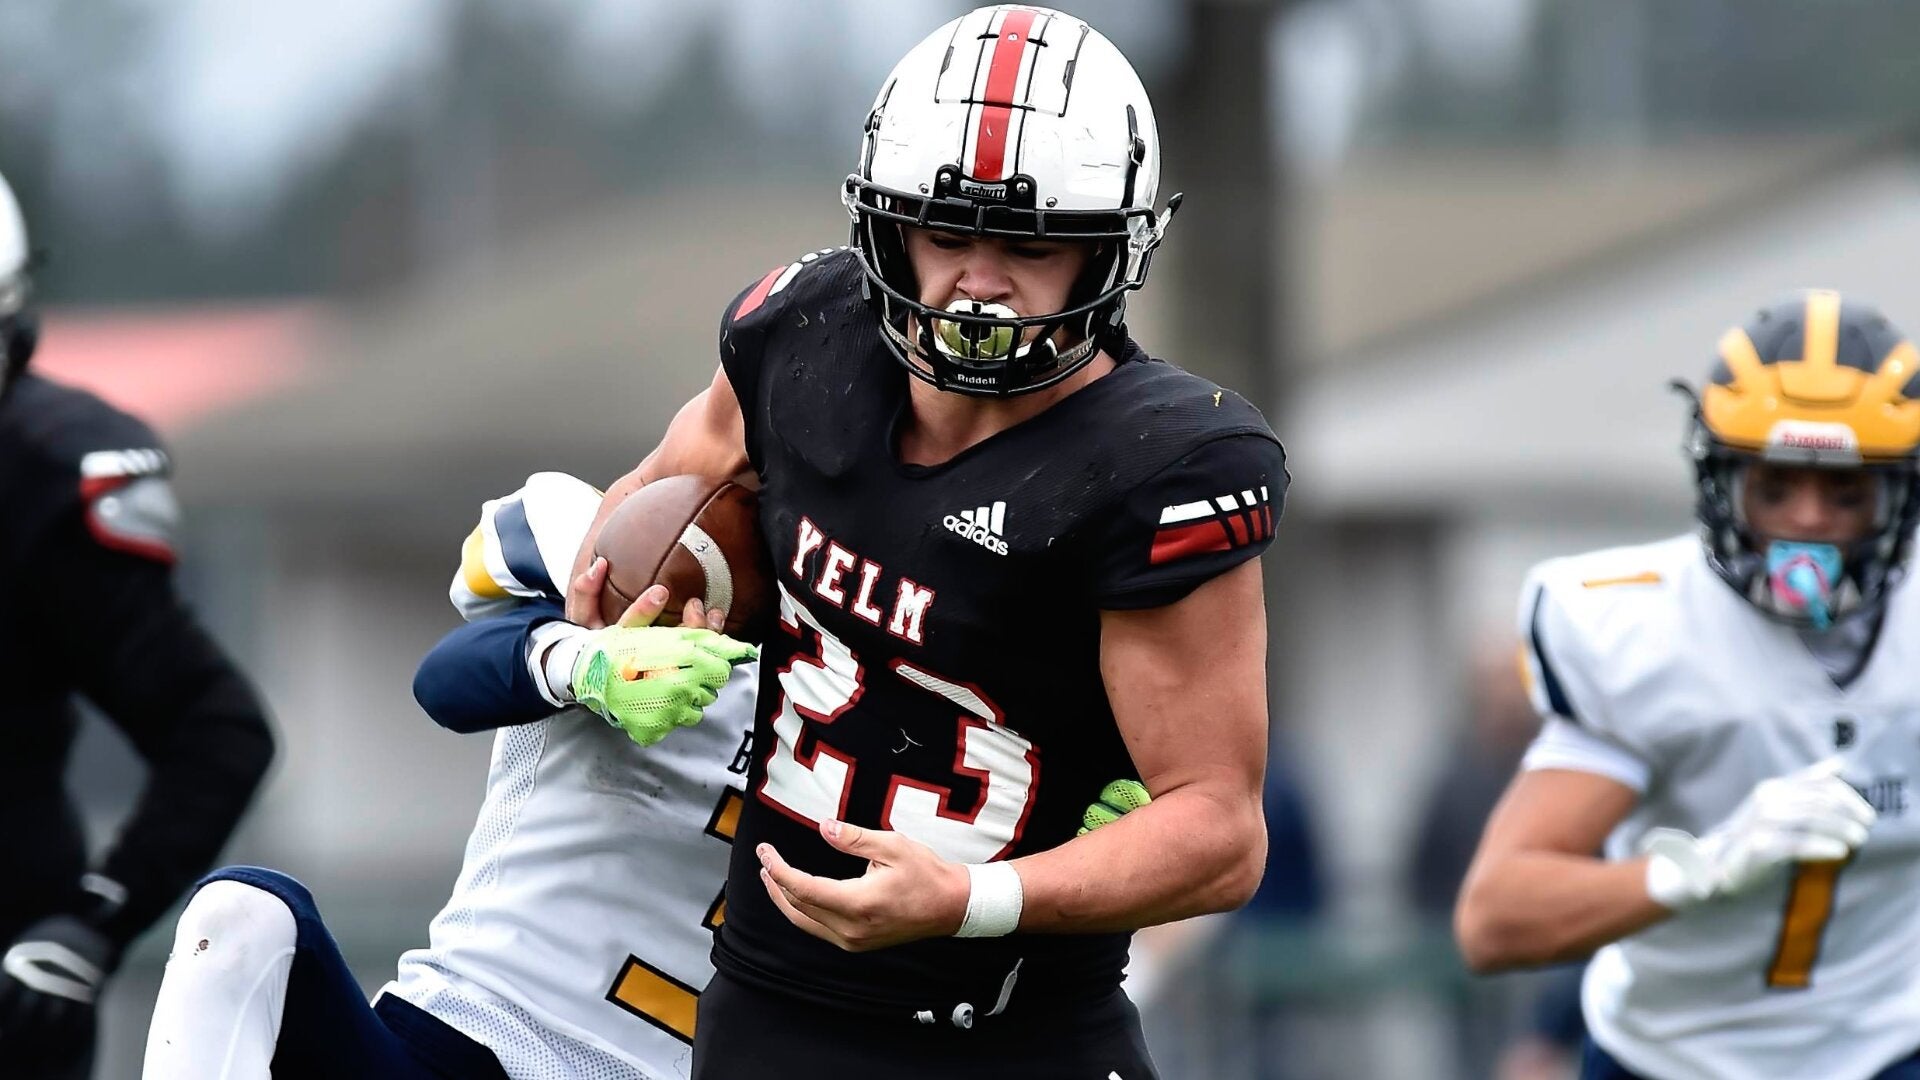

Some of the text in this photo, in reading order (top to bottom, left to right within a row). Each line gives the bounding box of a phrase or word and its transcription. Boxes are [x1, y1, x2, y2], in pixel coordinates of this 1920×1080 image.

[957, 373, 996, 385] Riddell
[943, 514, 1009, 556] adidas
[791, 516, 936, 646] YELM
[756, 580, 1041, 863] 23
